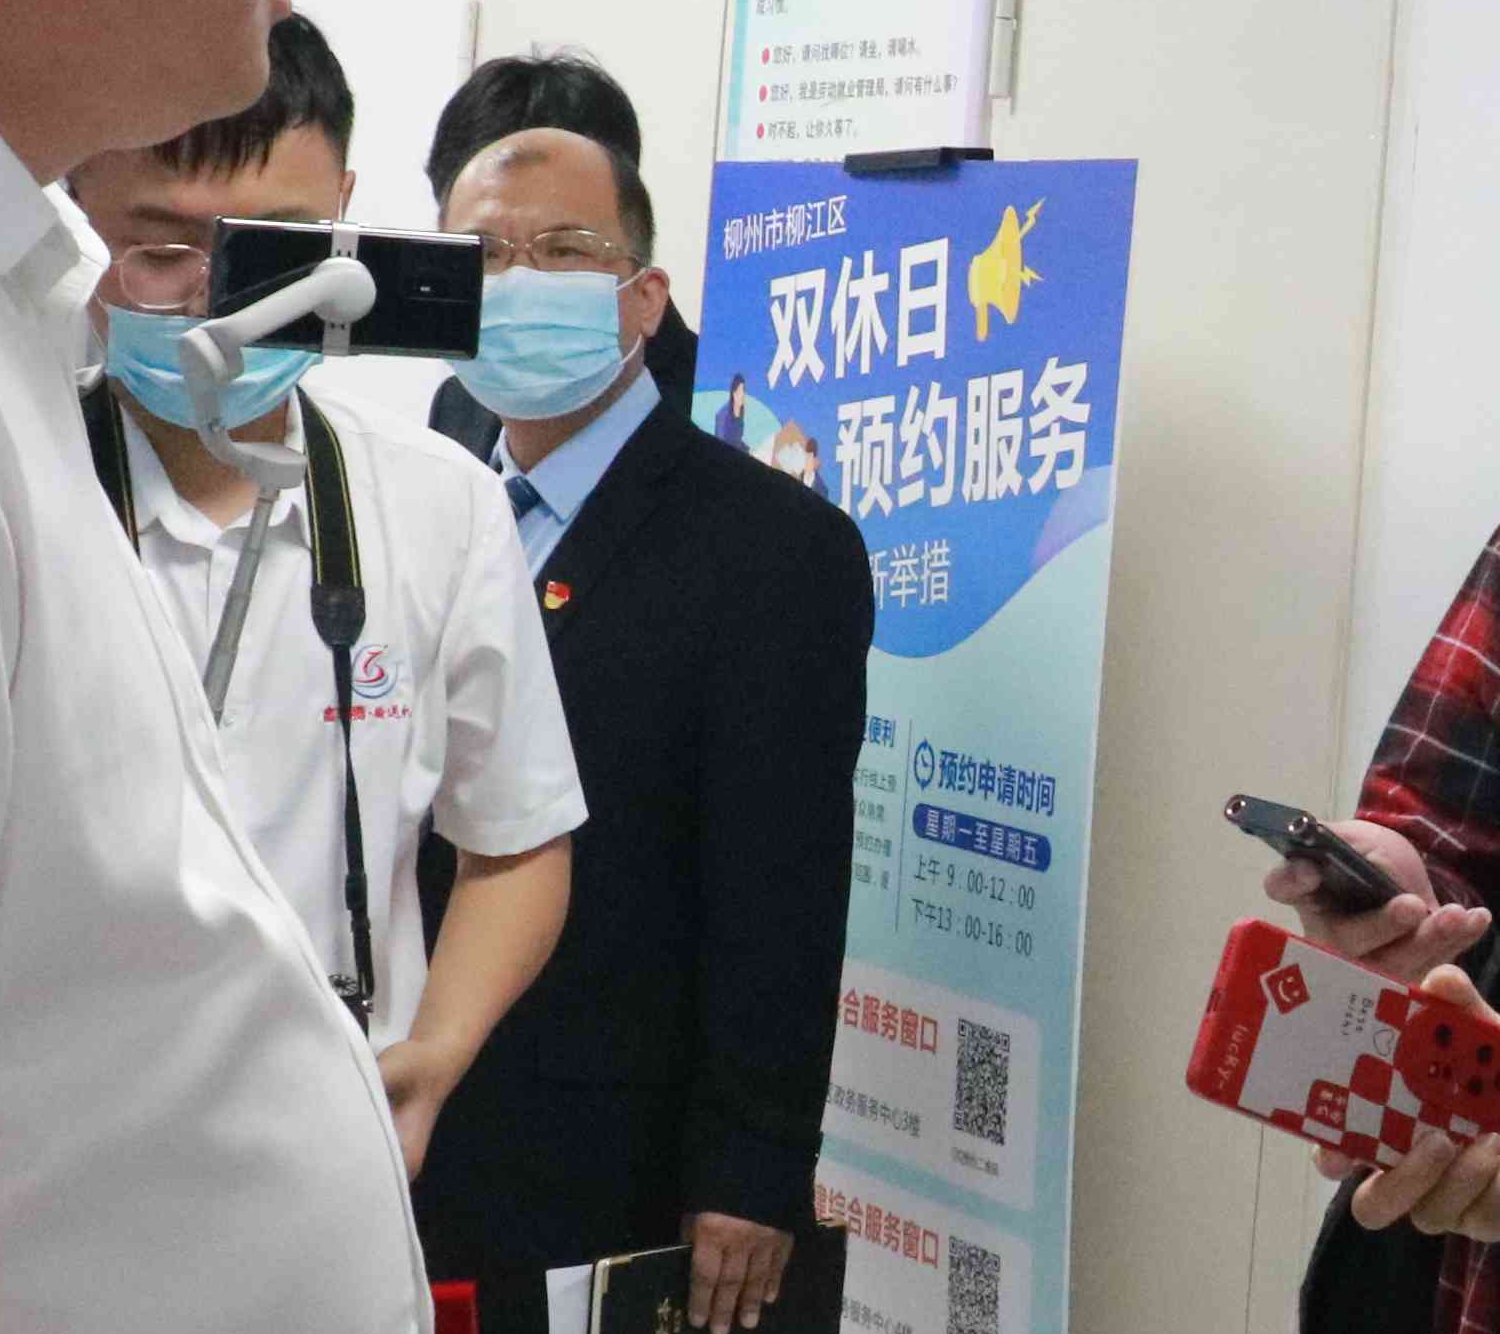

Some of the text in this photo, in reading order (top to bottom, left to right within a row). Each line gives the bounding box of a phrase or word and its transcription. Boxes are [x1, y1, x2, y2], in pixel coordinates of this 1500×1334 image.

[723, 195, 848, 260] 柳州市柳江区
[766, 238, 950, 389] 双休日
[835, 356, 1093, 519] 预约服务
[863, 713, 897, 748] 便利
[938, 750, 1057, 818] 预约申请时间
[913, 854, 942, 884] 上午
[926, 809, 1038, 866] 星期一至星期五
[838, 987, 939, 1054] 合服务窗口
